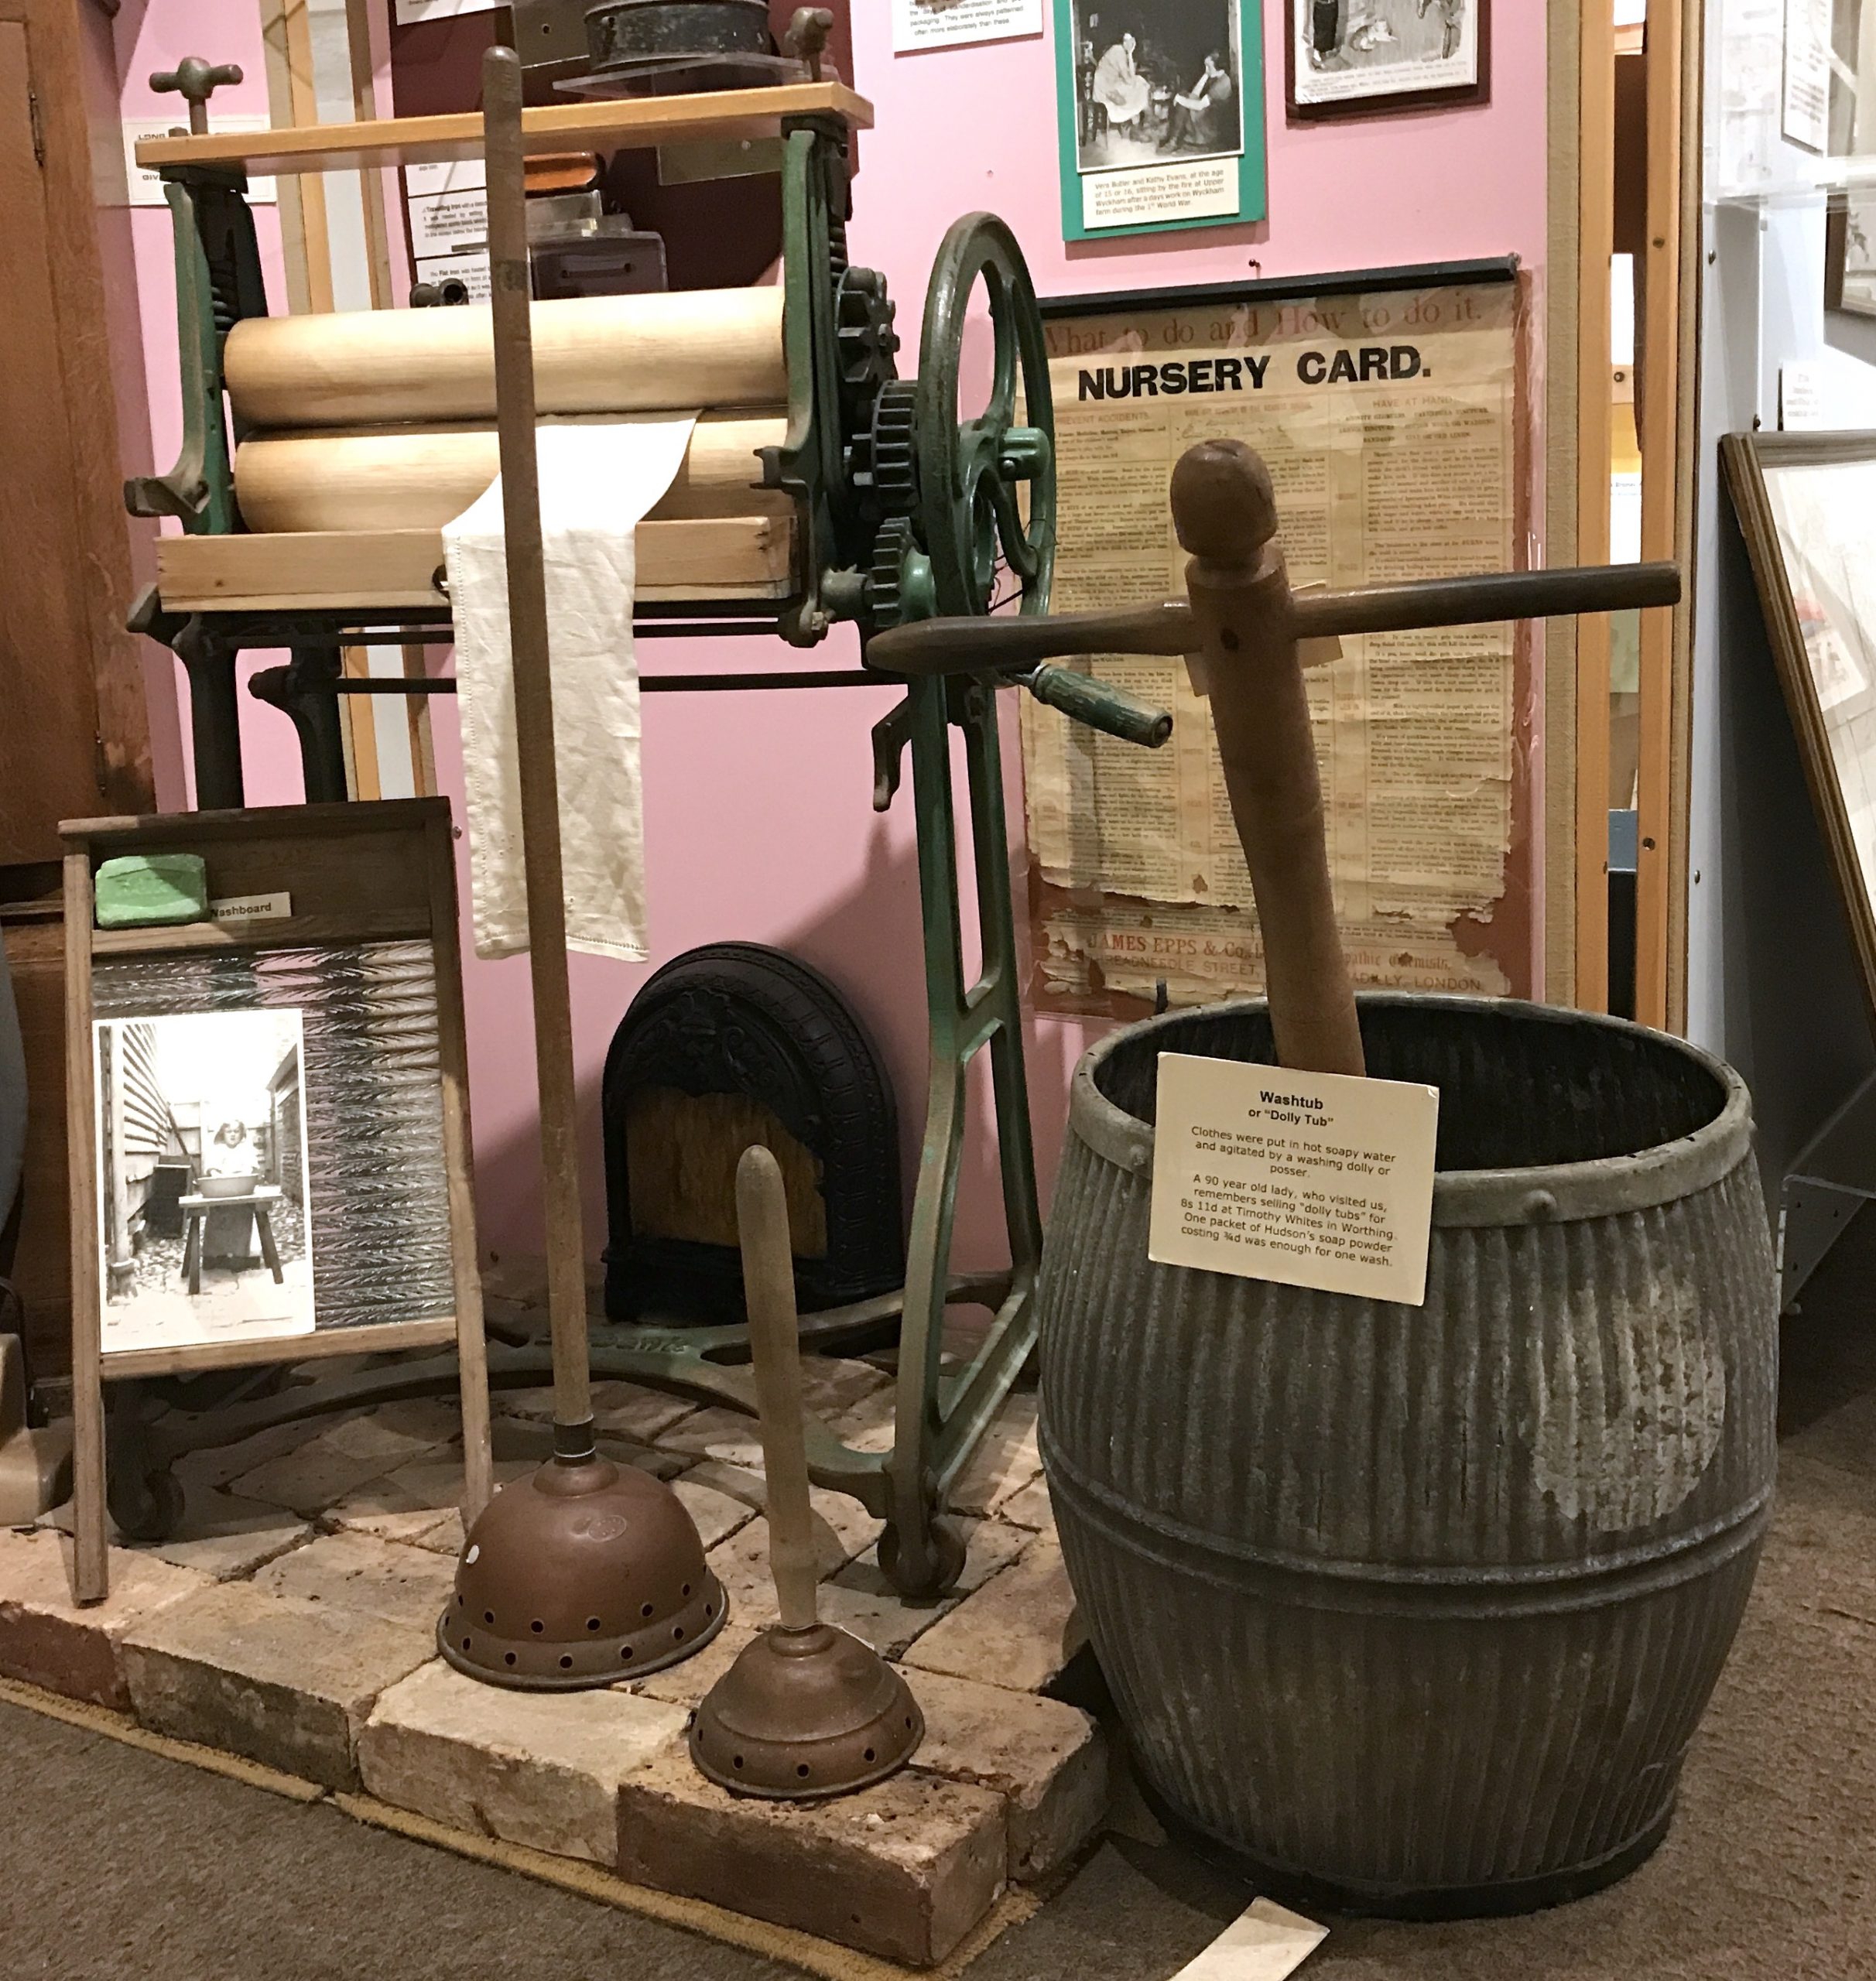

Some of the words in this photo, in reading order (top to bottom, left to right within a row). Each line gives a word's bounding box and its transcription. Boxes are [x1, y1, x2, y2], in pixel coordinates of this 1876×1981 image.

[1136, 185, 1155, 193] sitting
[1203, 178, 1224, 186] Upper
[1113, 206, 1133, 214] during
[1163, 318, 1194, 345] do
[1210, 310, 1258, 340] and
[1276, 305, 1347, 335] How
[1363, 306, 1390, 329] to
[1404, 296, 1440, 324] do
[1455, 292, 1482, 321] it.
[1078, 355, 1271, 401] NURSERY
[1297, 345, 1431, 385] CARD.
[1373, 399, 1399, 409] HAVE
[1405, 398, 1418, 406] AT
[1087, 934, 1147, 953] JAMES
[1153, 937, 1197, 955] EPPS
[1203, 940, 1217, 955] &
[1414, 975, 1481, 990] LONDON
[1248, 1108, 1262, 1118] or
[1259, 1090, 1324, 1110] Washtub
[1192, 1126, 1232, 1141] Clothes
[1236, 1133, 1264, 1144] were
[1267, 1135, 1285, 1148] put
[1289, 1139, 1299, 1149] in
[1303, 1140, 1322, 1153] hot
[1326, 1144, 1359, 1159] soapy
[1363, 1151, 1396, 1162] water
[1195, 1141, 1217, 1151] and
[1220, 1145, 1265, 1158] agitated
[1268, 1150, 1283, 1162] by
[1285, 1153, 1292, 1162] a
[1296, 1155, 1343, 1171] washing
[1347, 1160, 1374, 1175] dolly
[1378, 1166, 1391, 1175] or
[1193, 1174, 1201, 1184] A
[1204, 1175, 1219, 1186] 90
[1222, 1179, 1247, 1190] year
[1251, 1182, 1268, 1193] old
[1271, 1184, 1298, 1199] lady,
[1302, 1189, 1326, 1203] who
[1329, 1194, 1366, 1208] visited
[1370, 1201, 1388, 1212] us,
[1194, 1189, 1257, 1205] remembers
[1260, 1196, 1296, 1212] selling
[1369, 1212, 1385, 1224] for
[1181, 1199, 1193, 1208] 8s
[1197, 1200, 1218, 1212] 11d
[1221, 1205, 1233, 1215] at
[1237, 1206, 1282, 1223] Timothy
[1285, 1213, 1323, 1229] Whites
[1327, 1220, 1337, 1230] in
[1181, 1225, 1220, 1241] costing
[1244, 1236, 1267, 1247] was
[1270, 1240, 1312, 1254] enough
[1315, 1245, 1331, 1257] for
[1335, 1249, 1356, 1261] one
[1360, 1252, 1393, 1267] wash.
[1184, 1212, 1207, 1224] One
[1210, 1216, 1247, 1232] packet
[1250, 1222, 1262, 1232] of
[1319, 1233, 1347, 1247] soap
[1350, 1237, 1393, 1253] powder
